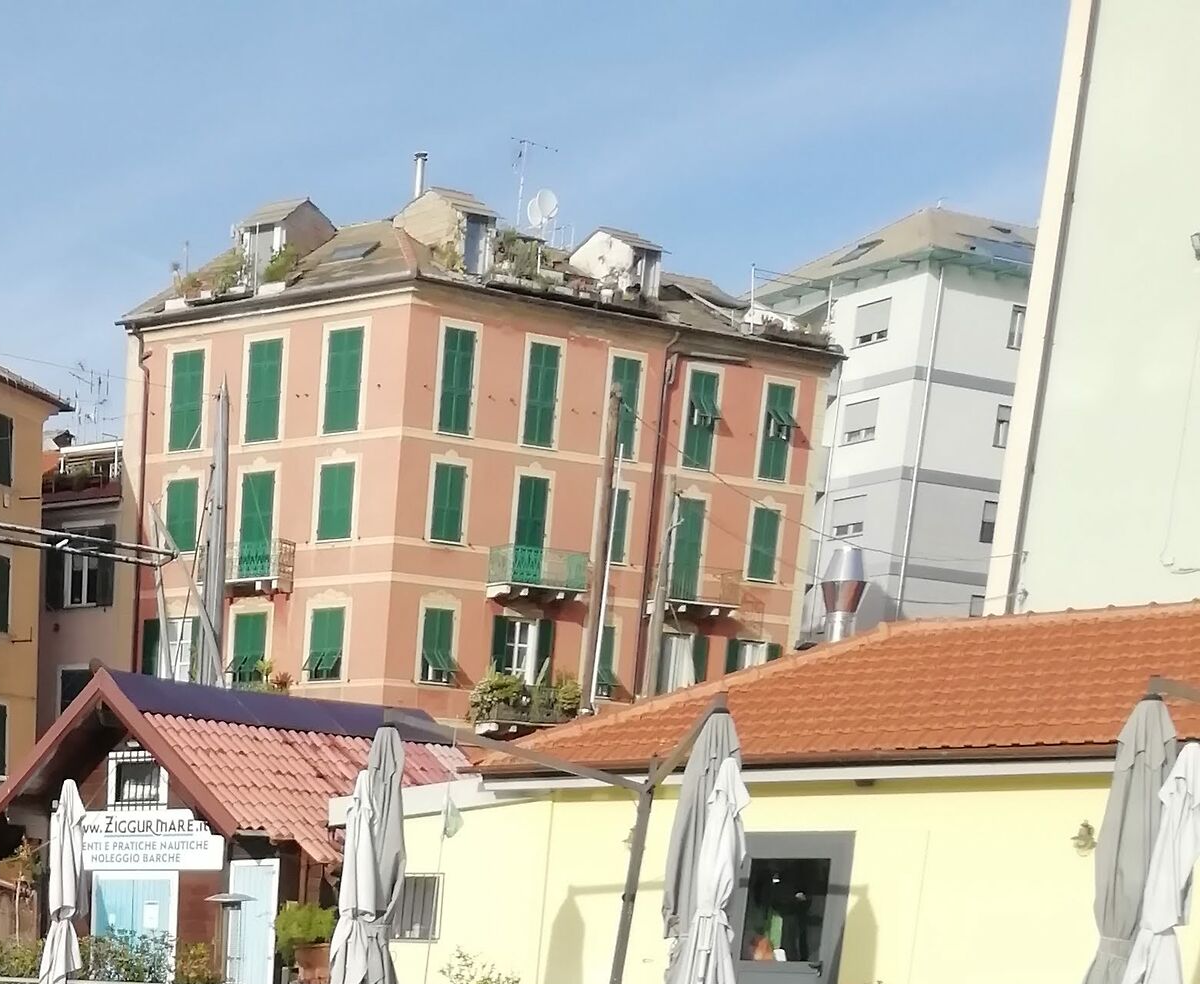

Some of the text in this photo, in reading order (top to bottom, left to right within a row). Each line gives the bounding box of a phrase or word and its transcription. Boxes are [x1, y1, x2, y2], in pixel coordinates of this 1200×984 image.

[81, 840, 209, 851] ENTI E PRATICHE NAUTICHE
[91, 853, 181, 863] NOLEGGIO BARCHE
